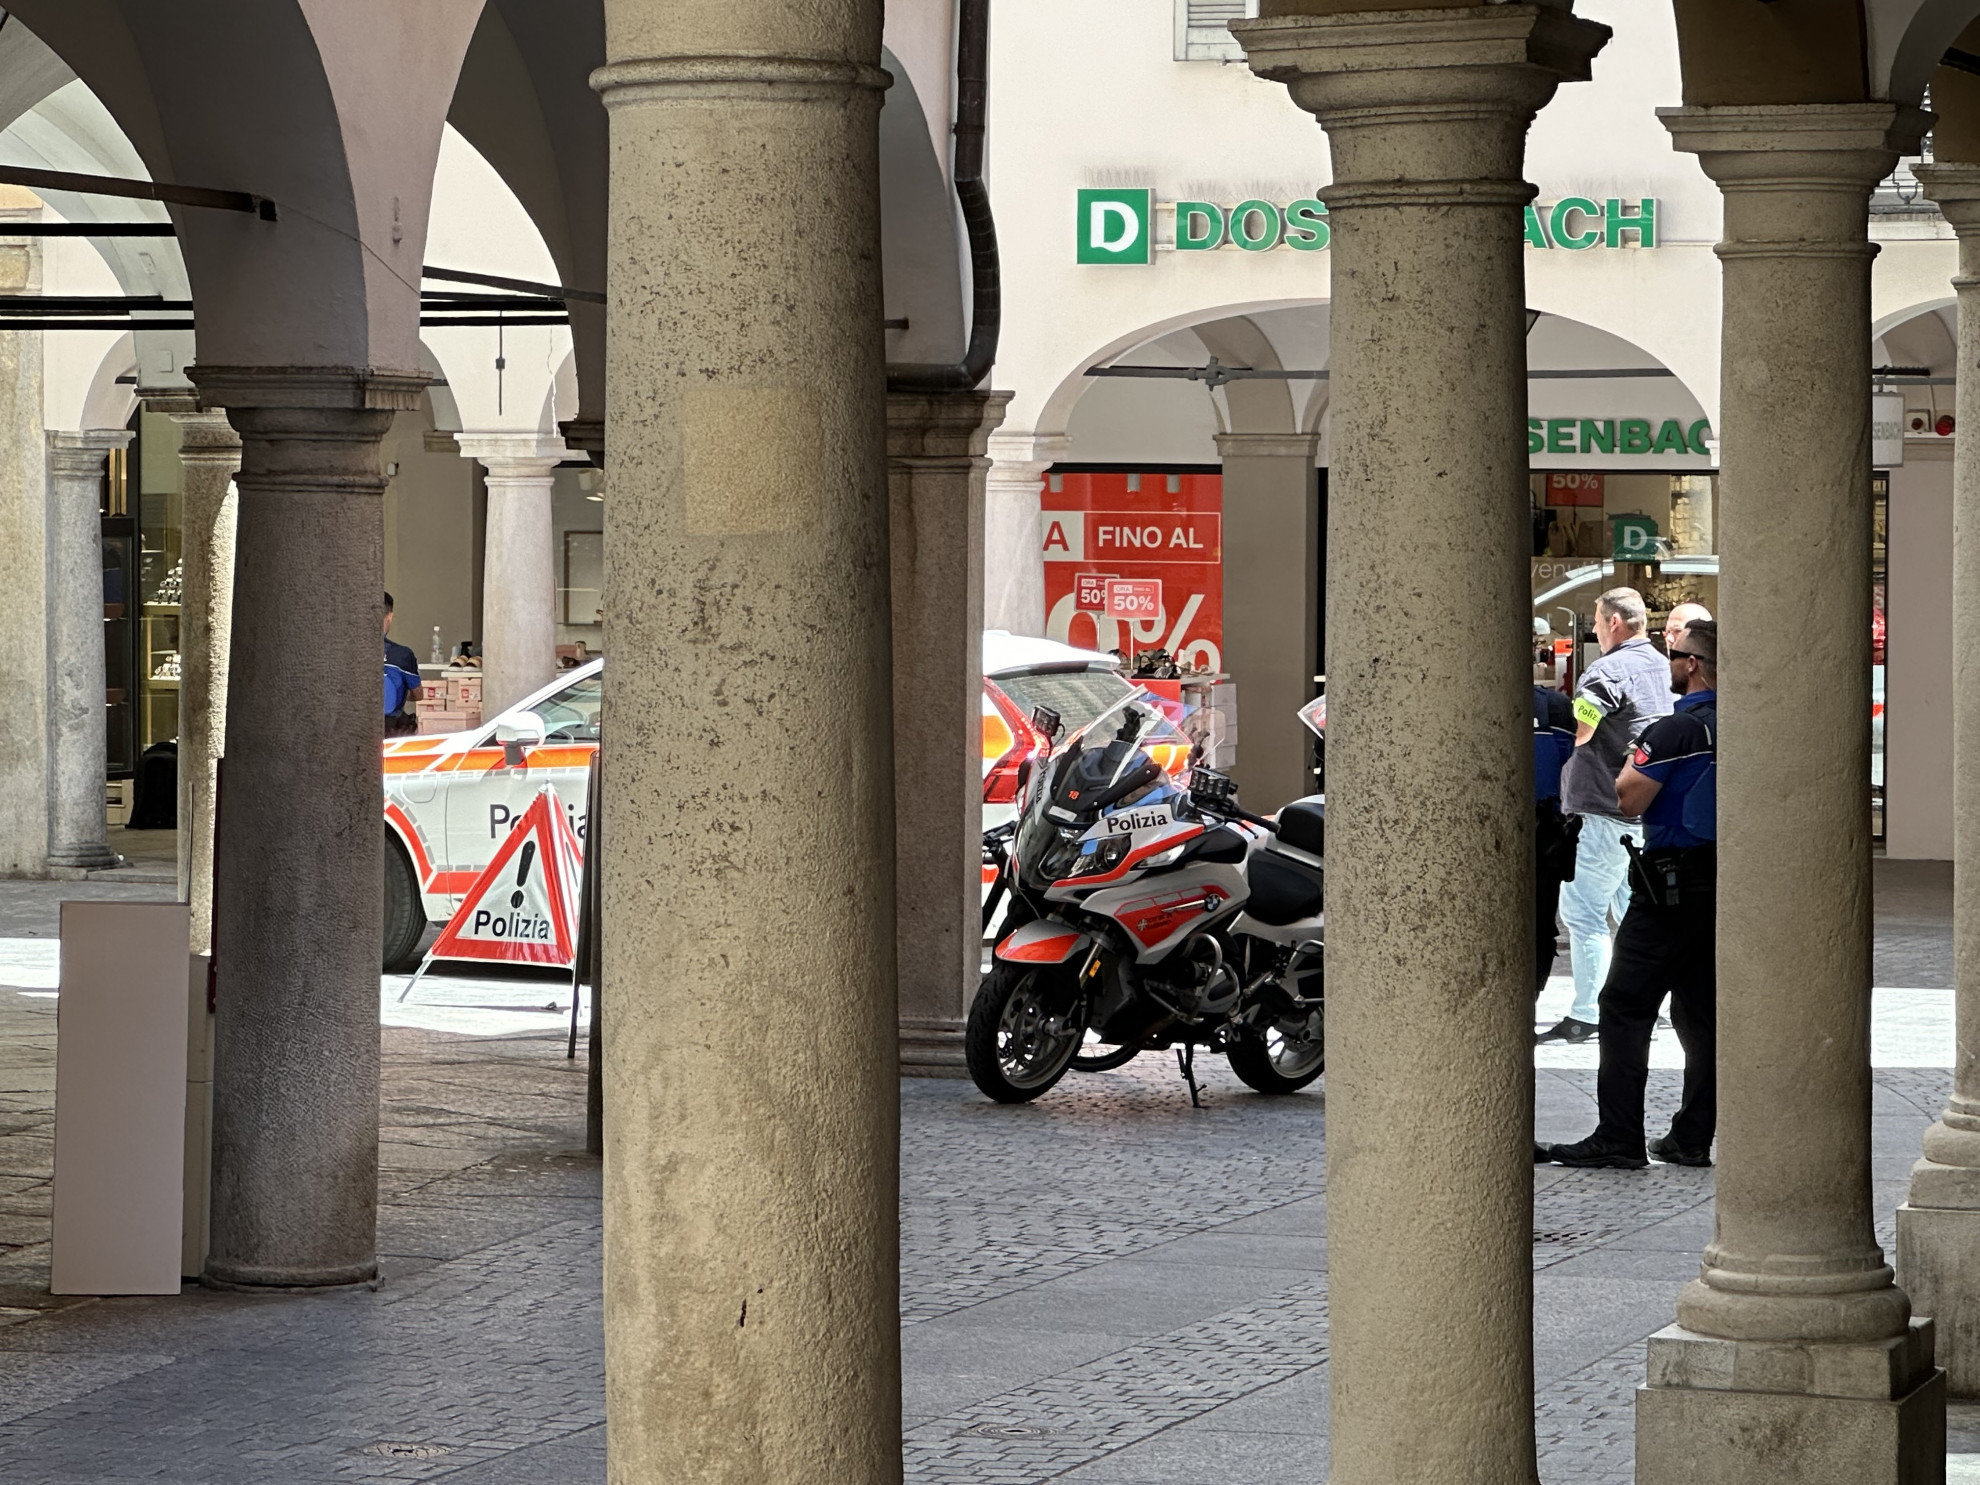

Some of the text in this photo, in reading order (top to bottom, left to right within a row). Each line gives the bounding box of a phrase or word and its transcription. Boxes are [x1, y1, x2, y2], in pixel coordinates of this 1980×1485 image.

[1091, 201, 1139, 252] D
[1552, 474, 1598, 489] 50%
[1098, 526, 1162, 548] FINO
[1169, 527, 1204, 548] AL
[1114, 595, 1154, 610] 50%
[1107, 811, 1168, 833] Polizia
[474, 910, 550, 940] Polizia
